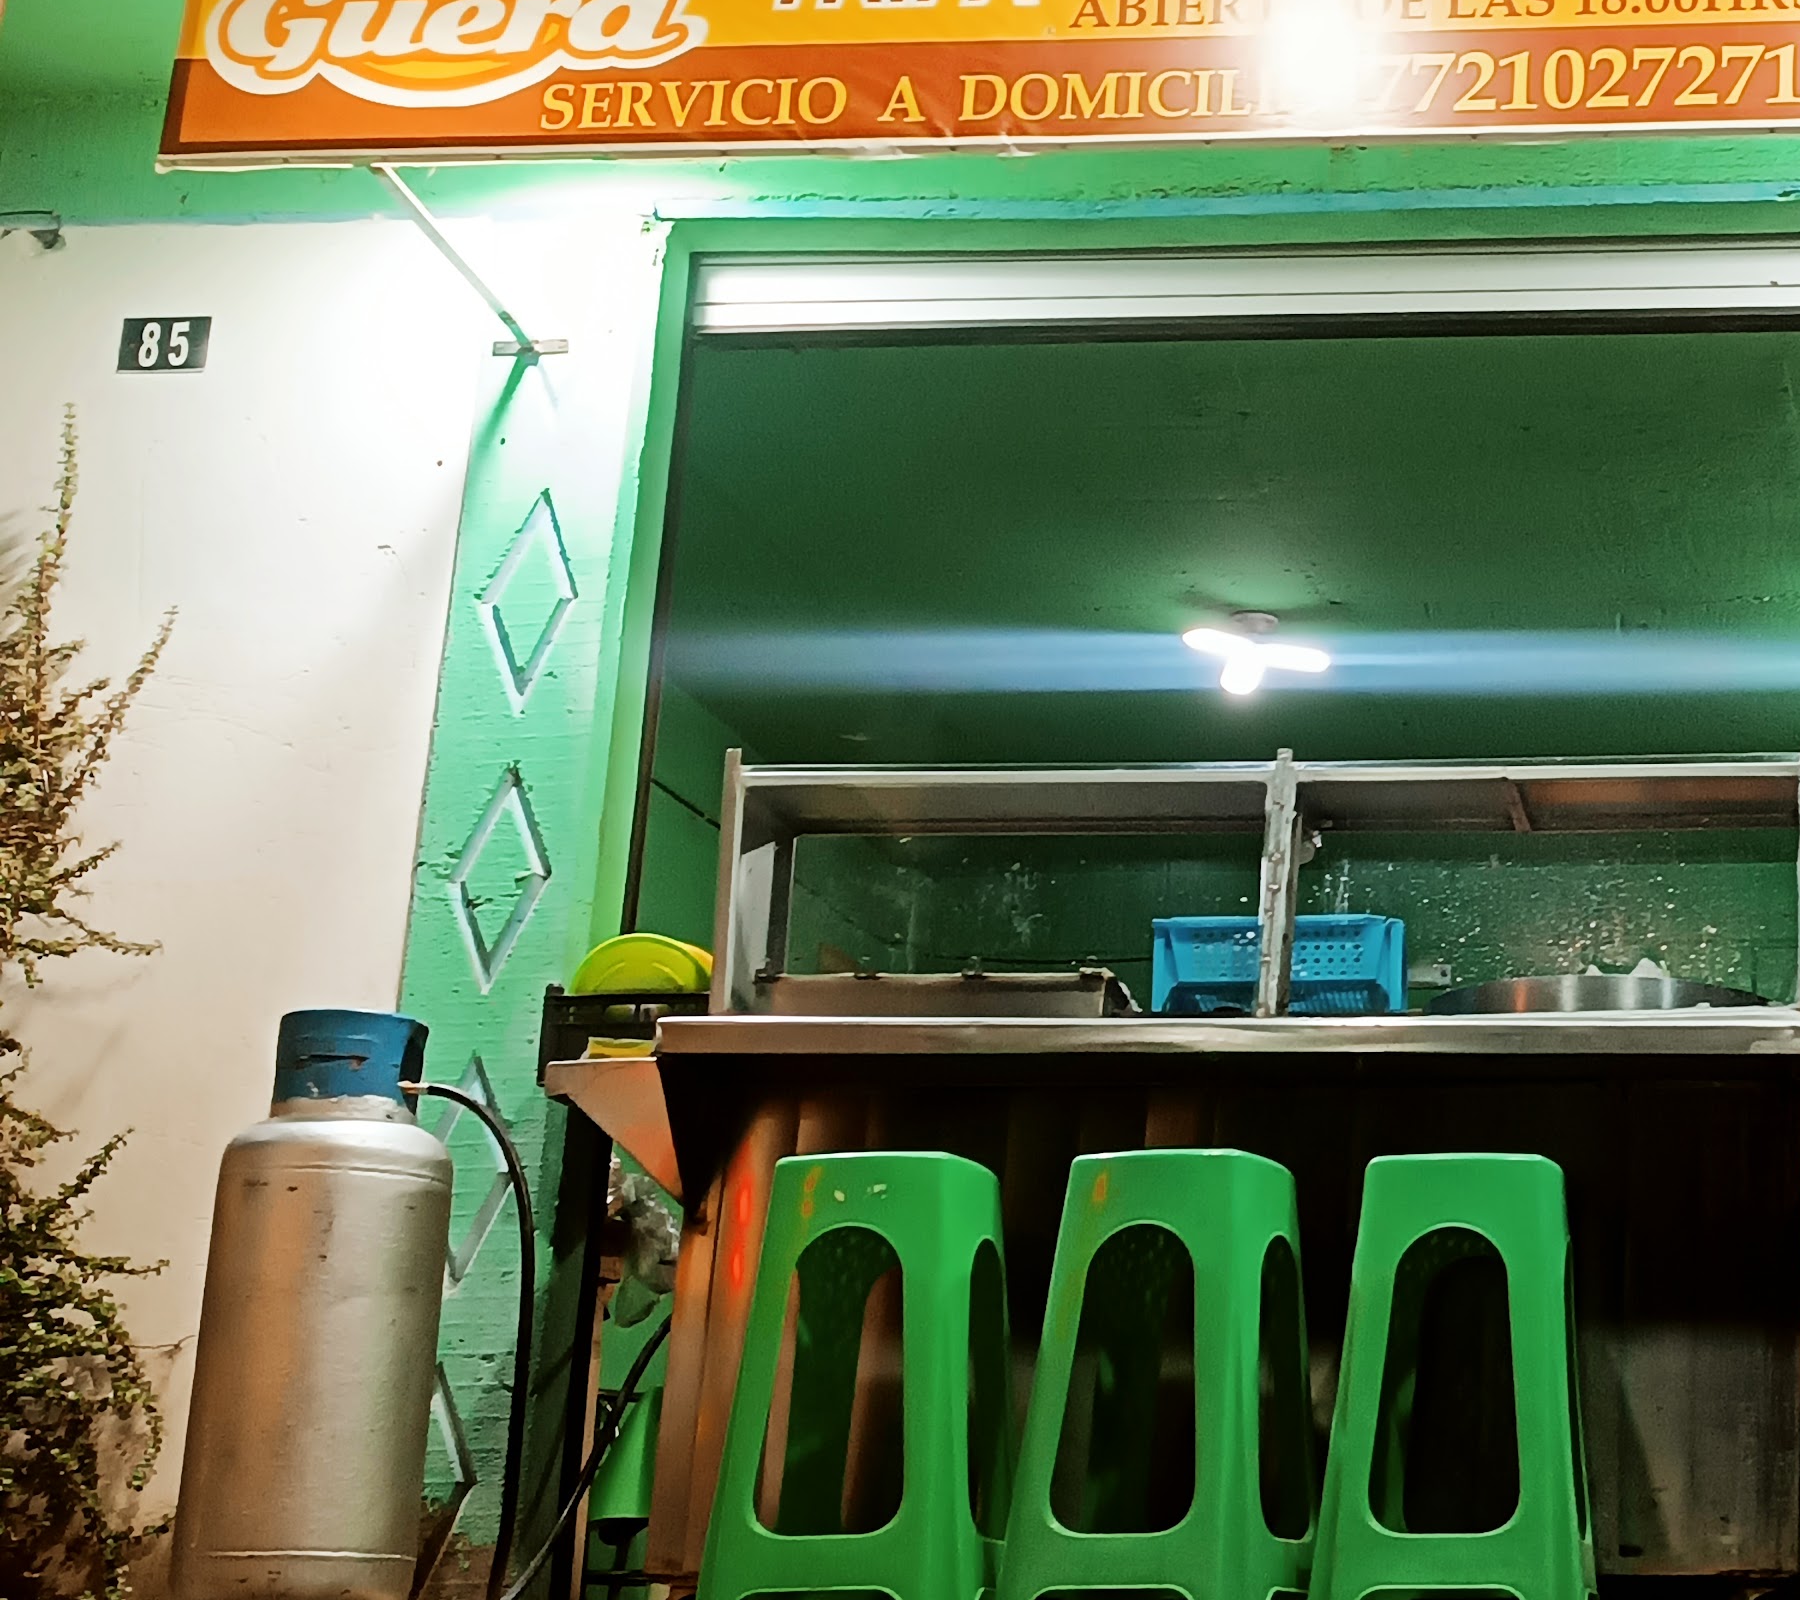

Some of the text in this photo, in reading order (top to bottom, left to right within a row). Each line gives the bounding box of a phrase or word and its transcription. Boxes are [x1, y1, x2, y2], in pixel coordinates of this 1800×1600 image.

[541, 74, 848, 131] SERVICIO
[877, 74, 926, 122] A
[959, 68, 1290, 123] DOMICIL
[138, 320, 190, 368] 85
